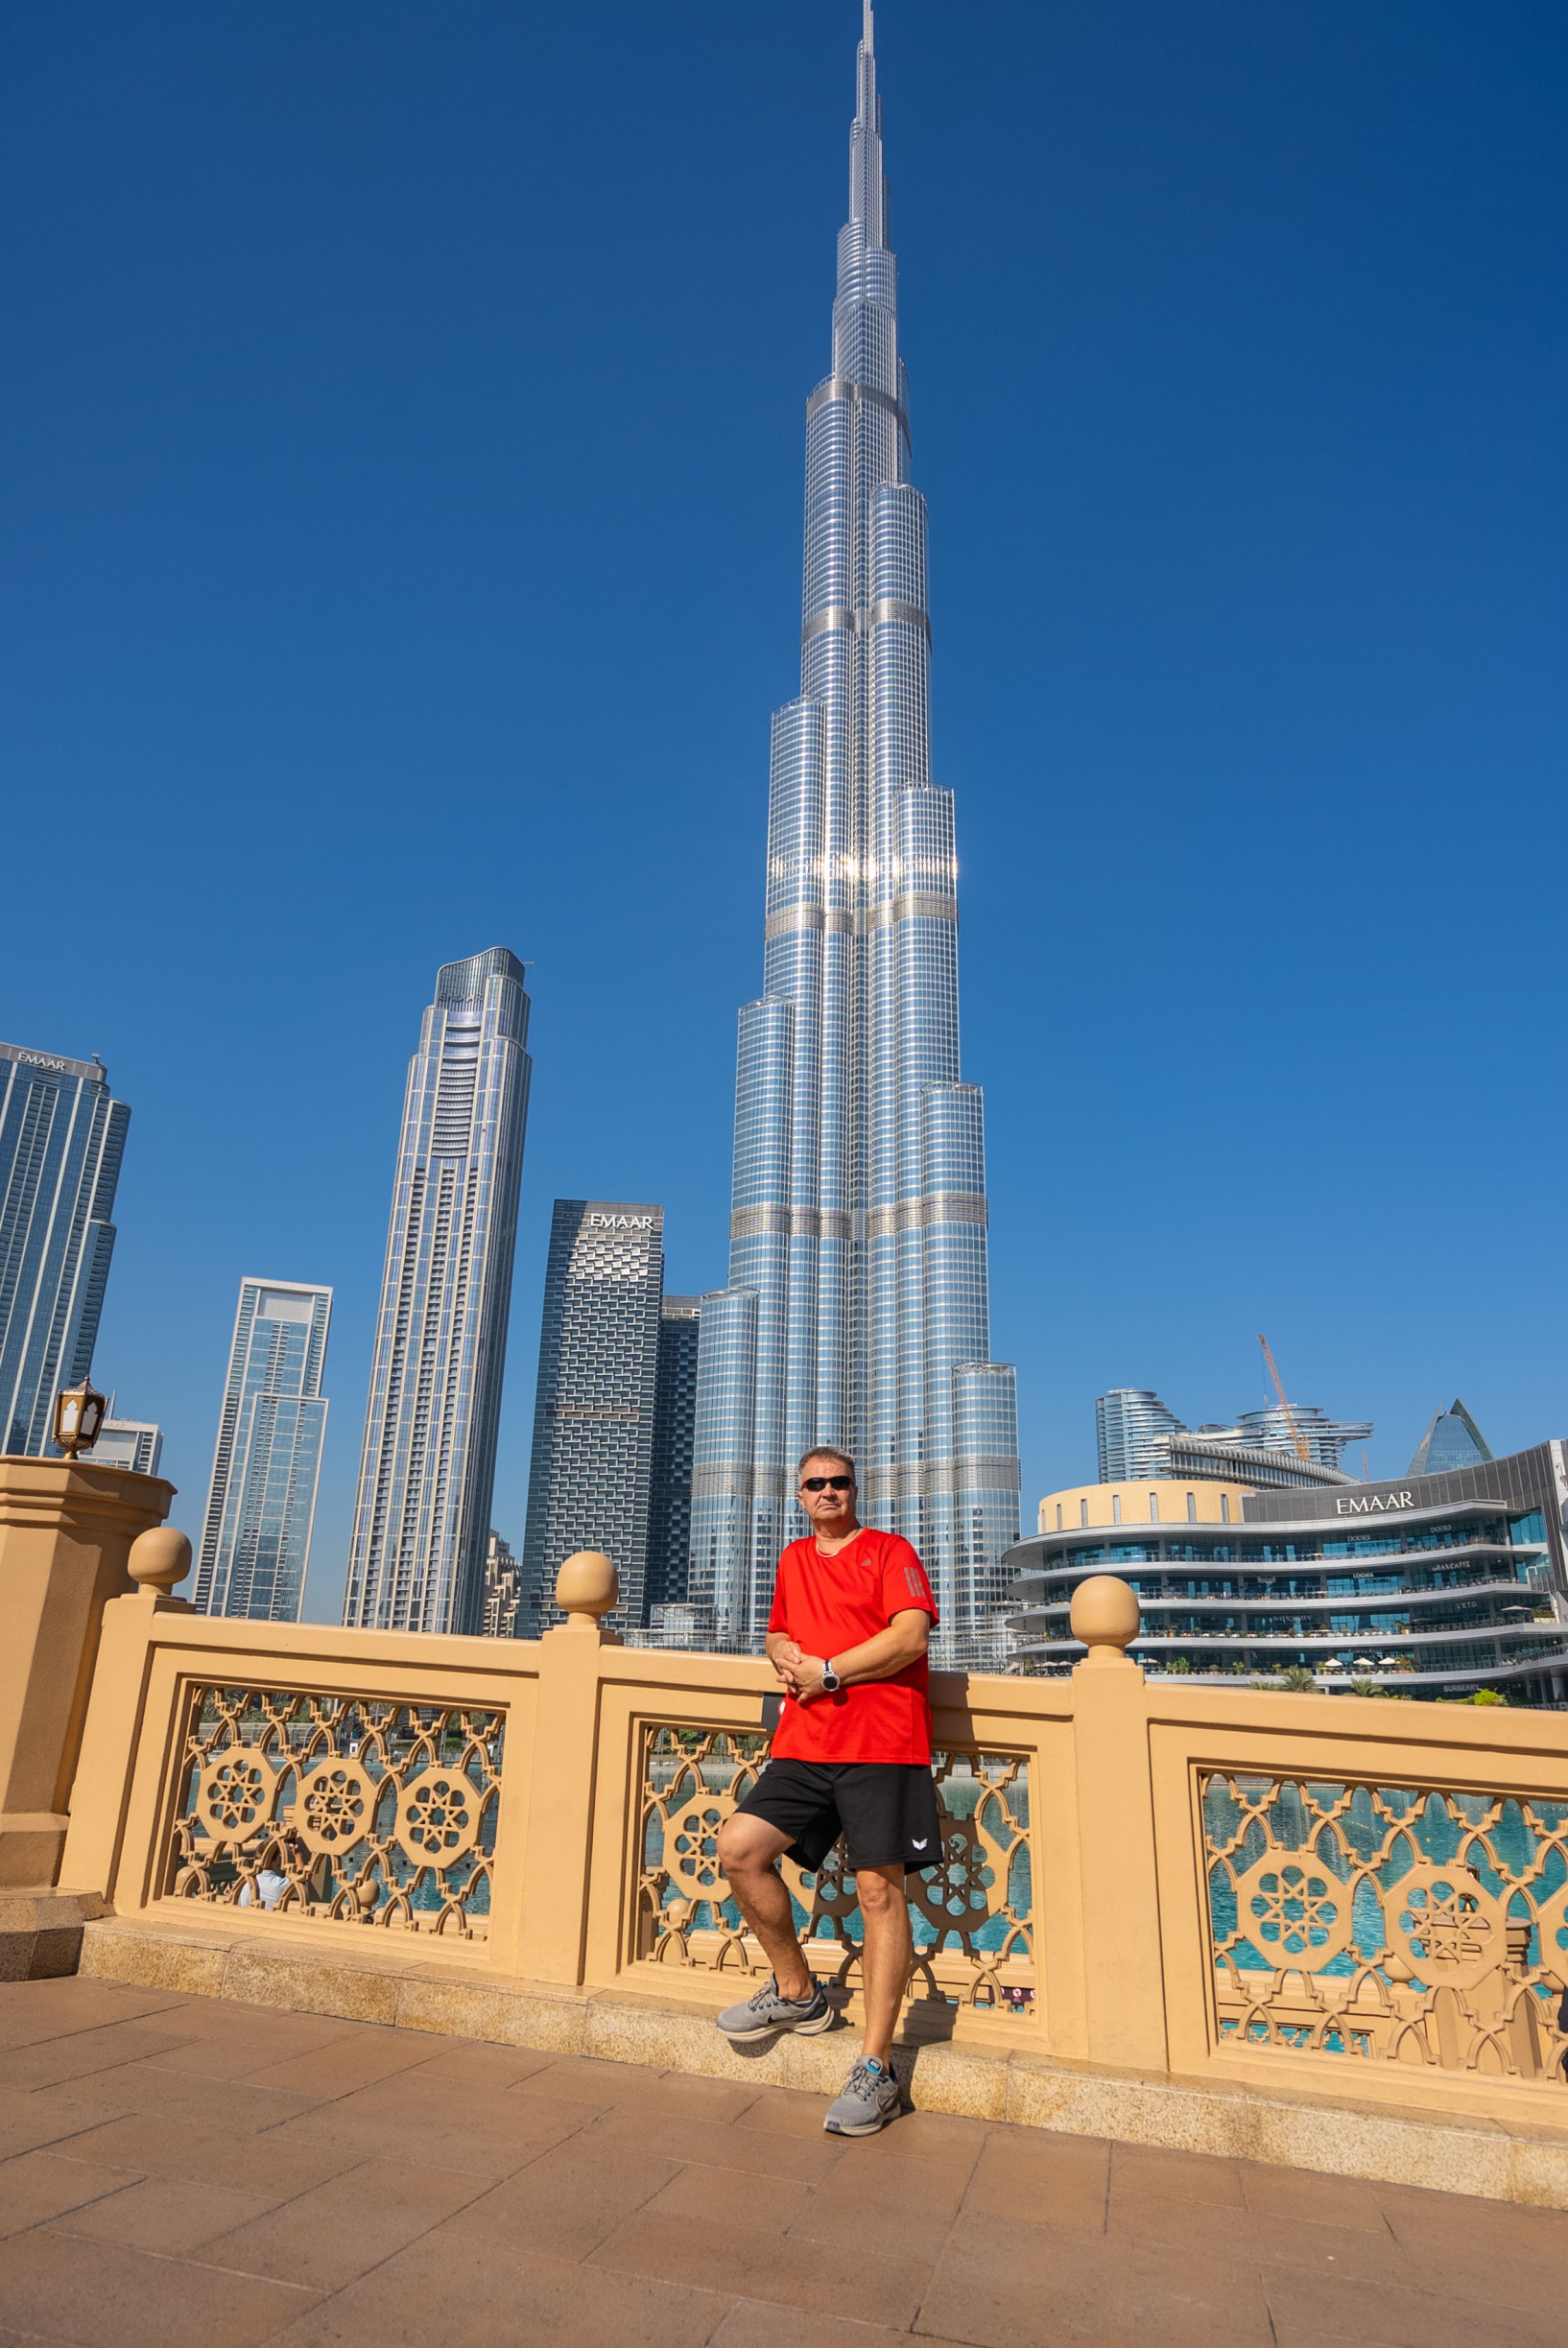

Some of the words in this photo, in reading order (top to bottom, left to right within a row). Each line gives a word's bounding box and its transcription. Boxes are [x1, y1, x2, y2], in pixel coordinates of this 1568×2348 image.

[17, 1052, 66, 1071] EMAAR
[590, 1213, 654, 1230] EMAAR
[1336, 1491, 1415, 1514] EMAAR
[1430, 1524, 1452, 1533] DOORS
